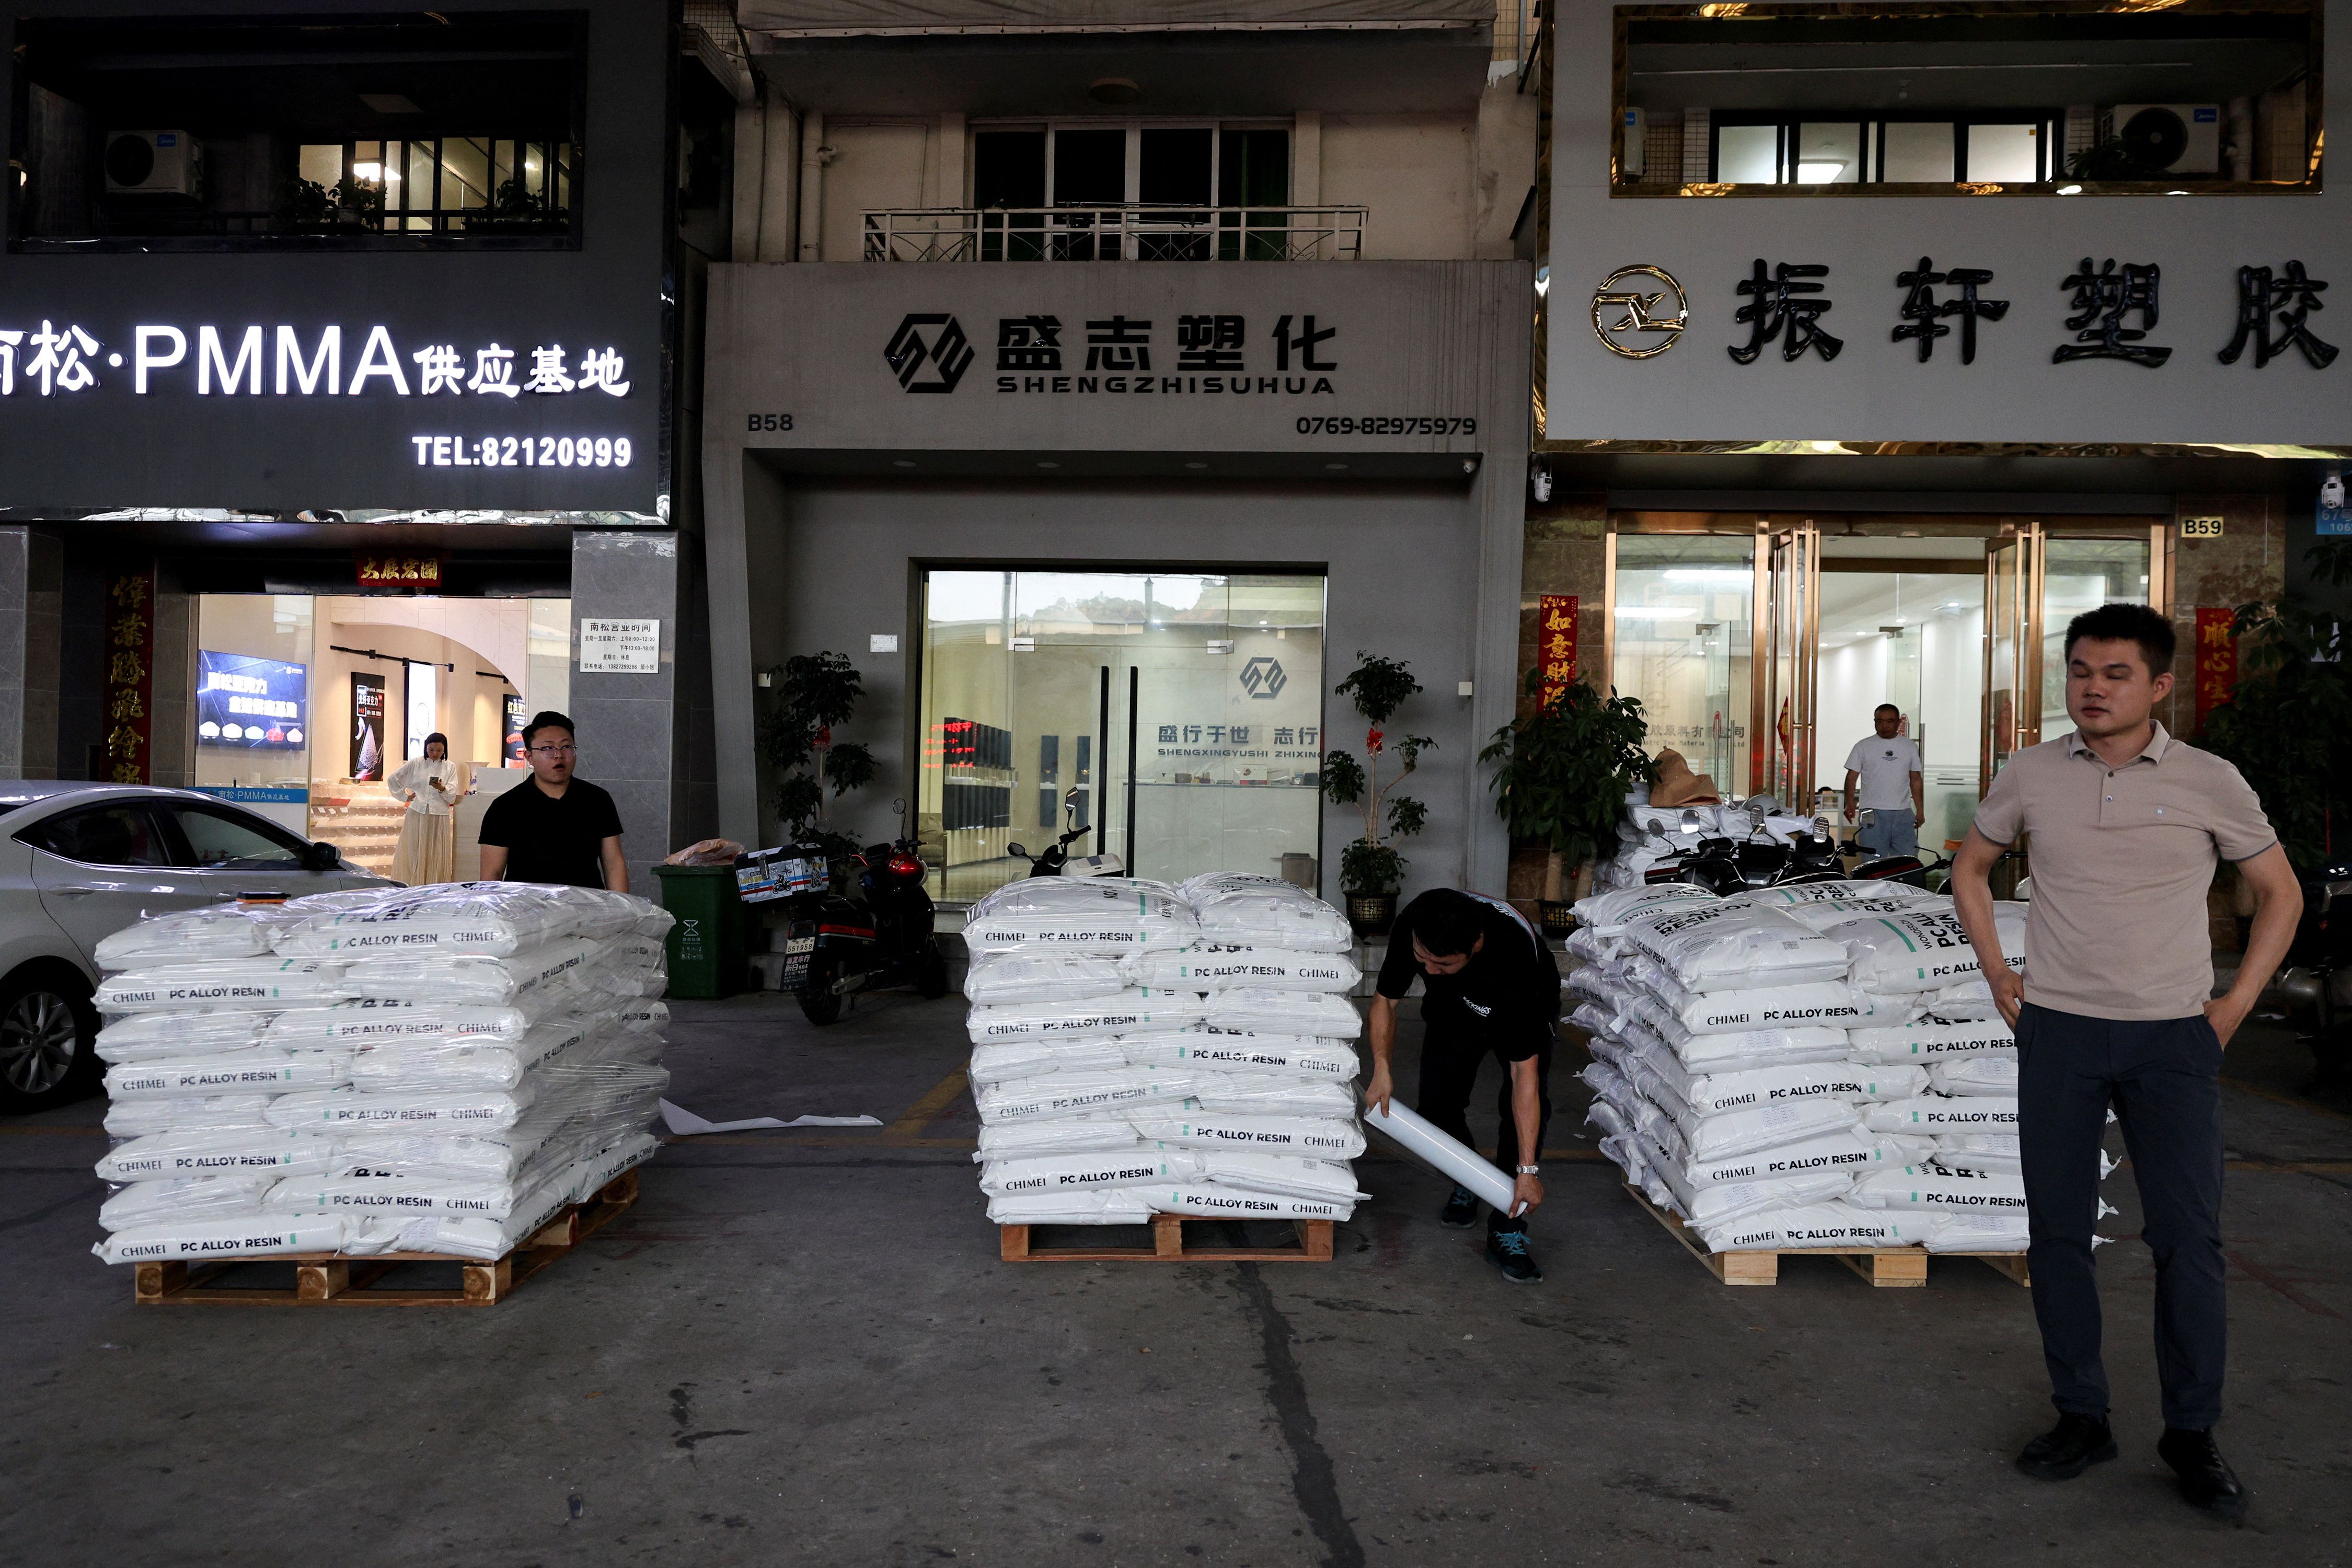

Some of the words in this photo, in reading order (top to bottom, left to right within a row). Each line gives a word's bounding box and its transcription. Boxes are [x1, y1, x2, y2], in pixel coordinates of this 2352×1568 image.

[1727, 256, 2340, 369] 振轩塑胶
[996, 314, 1338, 372] 盛志塑化
[997, 376, 1335, 394] SHENGZHISUHUA
[747, 414, 794, 432] B58
[1295, 417, 1477, 435] 0769-82975979
[412, 436, 632, 467] TEL:82120999
[2185, 520, 2222, 535] B59
[590, 621, 651, 632] 南松营业时间
[1158, 725, 1250, 744] 盛行于世
[1274, 727, 1319, 745] 志行
[1158, 748, 1269, 758] SHENGXINGYUSHI
[1688, 903, 1753, 917] ALLOY
[1659, 913, 1720, 935] RESIN
[402, 933, 437, 943] RESIN
[985, 932, 1025, 941] CHIMEI
[1099, 932, 1133, 941] RESIN
[1930, 928, 1956, 948] PC
[788, 943, 812, 952] 551958
[1195, 969, 1210, 977] PC
[1214, 965, 1249, 975] ALLOY
[1252, 966, 1285, 976] RESIN
[1299, 969, 1339, 979] CHIMEI
[1933, 966, 1950, 977] PC
[112, 991, 155, 1003] CHIMEI
[170, 990, 186, 999] PC
[189, 988, 228, 998] ALLOY
[232, 987, 265, 997] RESIN
[1707, 1013, 1749, 1025] CHIMEI
[1764, 1011, 1779, 1020] PC
[1782, 1008, 1822, 1019] ALLOY
[1825, 1007, 1858, 1017] RESIN
[406, 1024, 443, 1033] RESIN
[457, 1023, 502, 1033] CHIMEI
[988, 1024, 1029, 1035] CHIMEI
[1062, 1018, 1100, 1029] ALLOY
[1103, 1017, 1136, 1025] RESIN
[1927, 1043, 1943, 1053] PC
[1946, 1040, 1986, 1051] ALLOY
[1193, 1050, 1208, 1058] PC
[1212, 1051, 1247, 1062] ALLOY
[1252, 1055, 1286, 1065] RESIN
[1300, 1059, 1340, 1073] CHIMEI
[122, 1079, 165, 1090] CHIMEI
[180, 1076, 195, 1086] PC
[199, 1074, 237, 1085] ALLOY
[241, 1072, 276, 1081] RESIN
[1000, 1104, 1039, 1117] CHIMEI
[1053, 1100, 1068, 1109] PC
[1071, 1093, 1108, 1106] ALLOY
[1715, 1093, 1756, 1109] CHIMEI
[1770, 1089, 1786, 1099] PC
[1790, 1084, 1828, 1096] ALLOY
[1831, 1083, 1862, 1093] RESIN
[339, 1111, 354, 1119] PC
[357, 1110, 397, 1120] ALLOY
[400, 1110, 436, 1120] RESIN
[452, 1109, 493, 1119] CHIMEI
[1928, 1113, 1945, 1122] PC
[1948, 1113, 1988, 1122] ALLOY
[1217, 1130, 1253, 1140] ALLOY
[1256, 1133, 1290, 1143] RESIN
[1305, 1136, 1344, 1148] CHIMEI
[118, 1160, 161, 1172] CHIMEI
[176, 1158, 193, 1168] PC
[196, 1157, 236, 1167] ALLOY
[241, 1156, 276, 1165] RESIN
[1713, 1166, 1755, 1180] CHIMEI
[1769, 1162, 1785, 1172] PC
[1789, 1157, 1828, 1170] ALLOY
[1831, 1152, 1867, 1165] RESIN
[1006, 1178, 1046, 1190] CHIMEI
[1060, 1175, 1076, 1184] PC
[1079, 1171, 1116, 1182] ALLOY
[1120, 1168, 1153, 1179] RESIN
[334, 1196, 350, 1205] PC
[353, 1196, 393, 1205] ALLOY
[397, 1197, 432, 1207] RESIN
[446, 1200, 489, 1209] CHIMEI
[1186, 1196, 1202, 1205] PC
[1205, 1197, 1242, 1208] ALLOY
[1245, 1201, 1278, 1210] RESIN
[1292, 1204, 1332, 1214] CHIMEI
[1927, 1194, 1943, 1203] PC
[1945, 1195, 1987, 1205] ALLOY
[1989, 1197, 2026, 1207] RESIN
[1734, 1231, 1774, 1245] CHIMEI
[1787, 1231, 1804, 1239] PC
[1807, 1229, 1846, 1239] ALLOY
[1849, 1228, 1885, 1237] RESIN
[121, 1245, 166, 1256] CHIMEI
[181, 1242, 198, 1252] PC
[201, 1240, 240, 1251] ALLOY
[245, 1237, 282, 1248] RESIN
